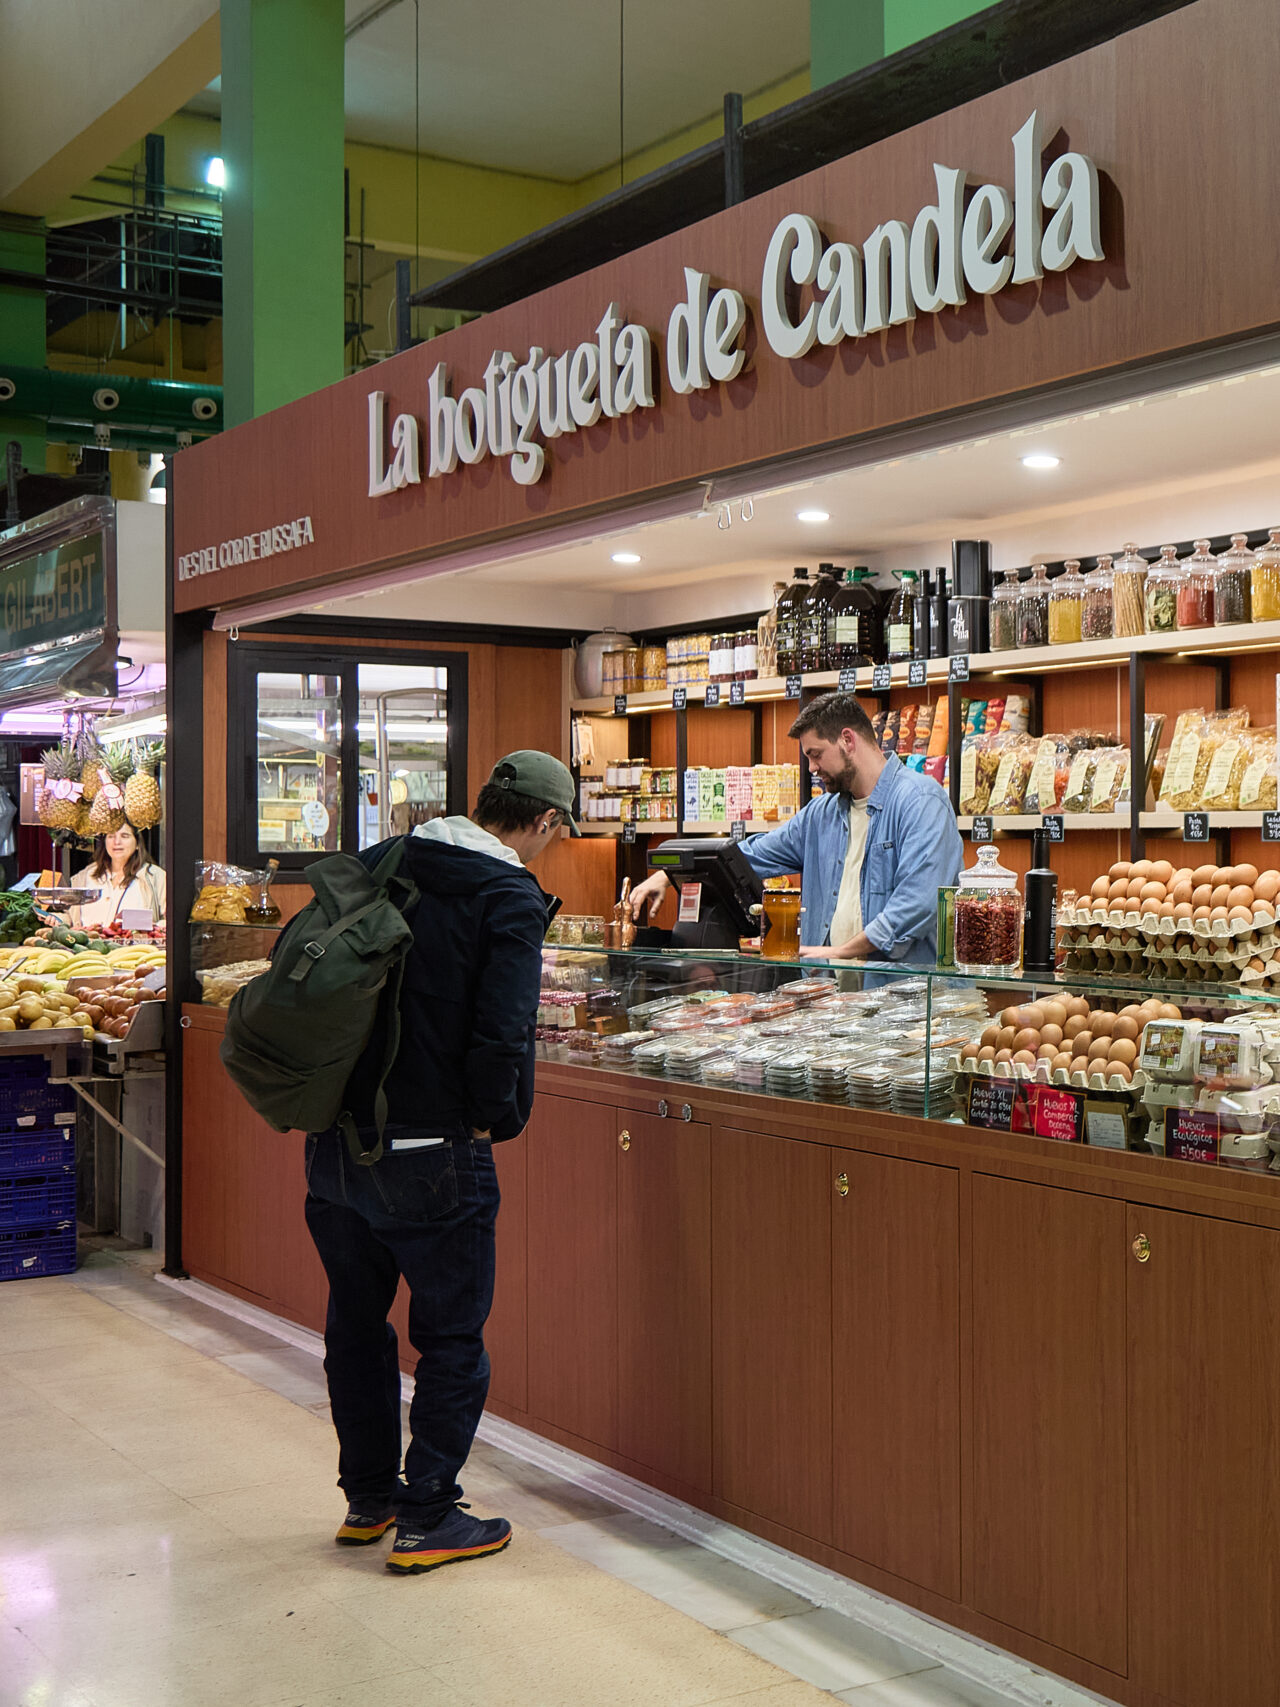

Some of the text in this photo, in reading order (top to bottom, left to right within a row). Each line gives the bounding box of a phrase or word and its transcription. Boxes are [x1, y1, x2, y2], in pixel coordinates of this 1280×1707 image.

[367, 109, 1106, 498] La botigueta de Candela
[219, 538, 244, 569] COR
[4, 553, 97, 636] GILABERT
[972, 1087, 1008, 1102] Huevos XL
[1043, 1097, 1080, 1115] Huevos XL
[1042, 1108, 1079, 1124] Camperos
[1178, 1118, 1206, 1133] Huevos
[1172, 1128, 1214, 1146] Ecológicos
[1180, 1144, 1208, 1161] 5'50€
